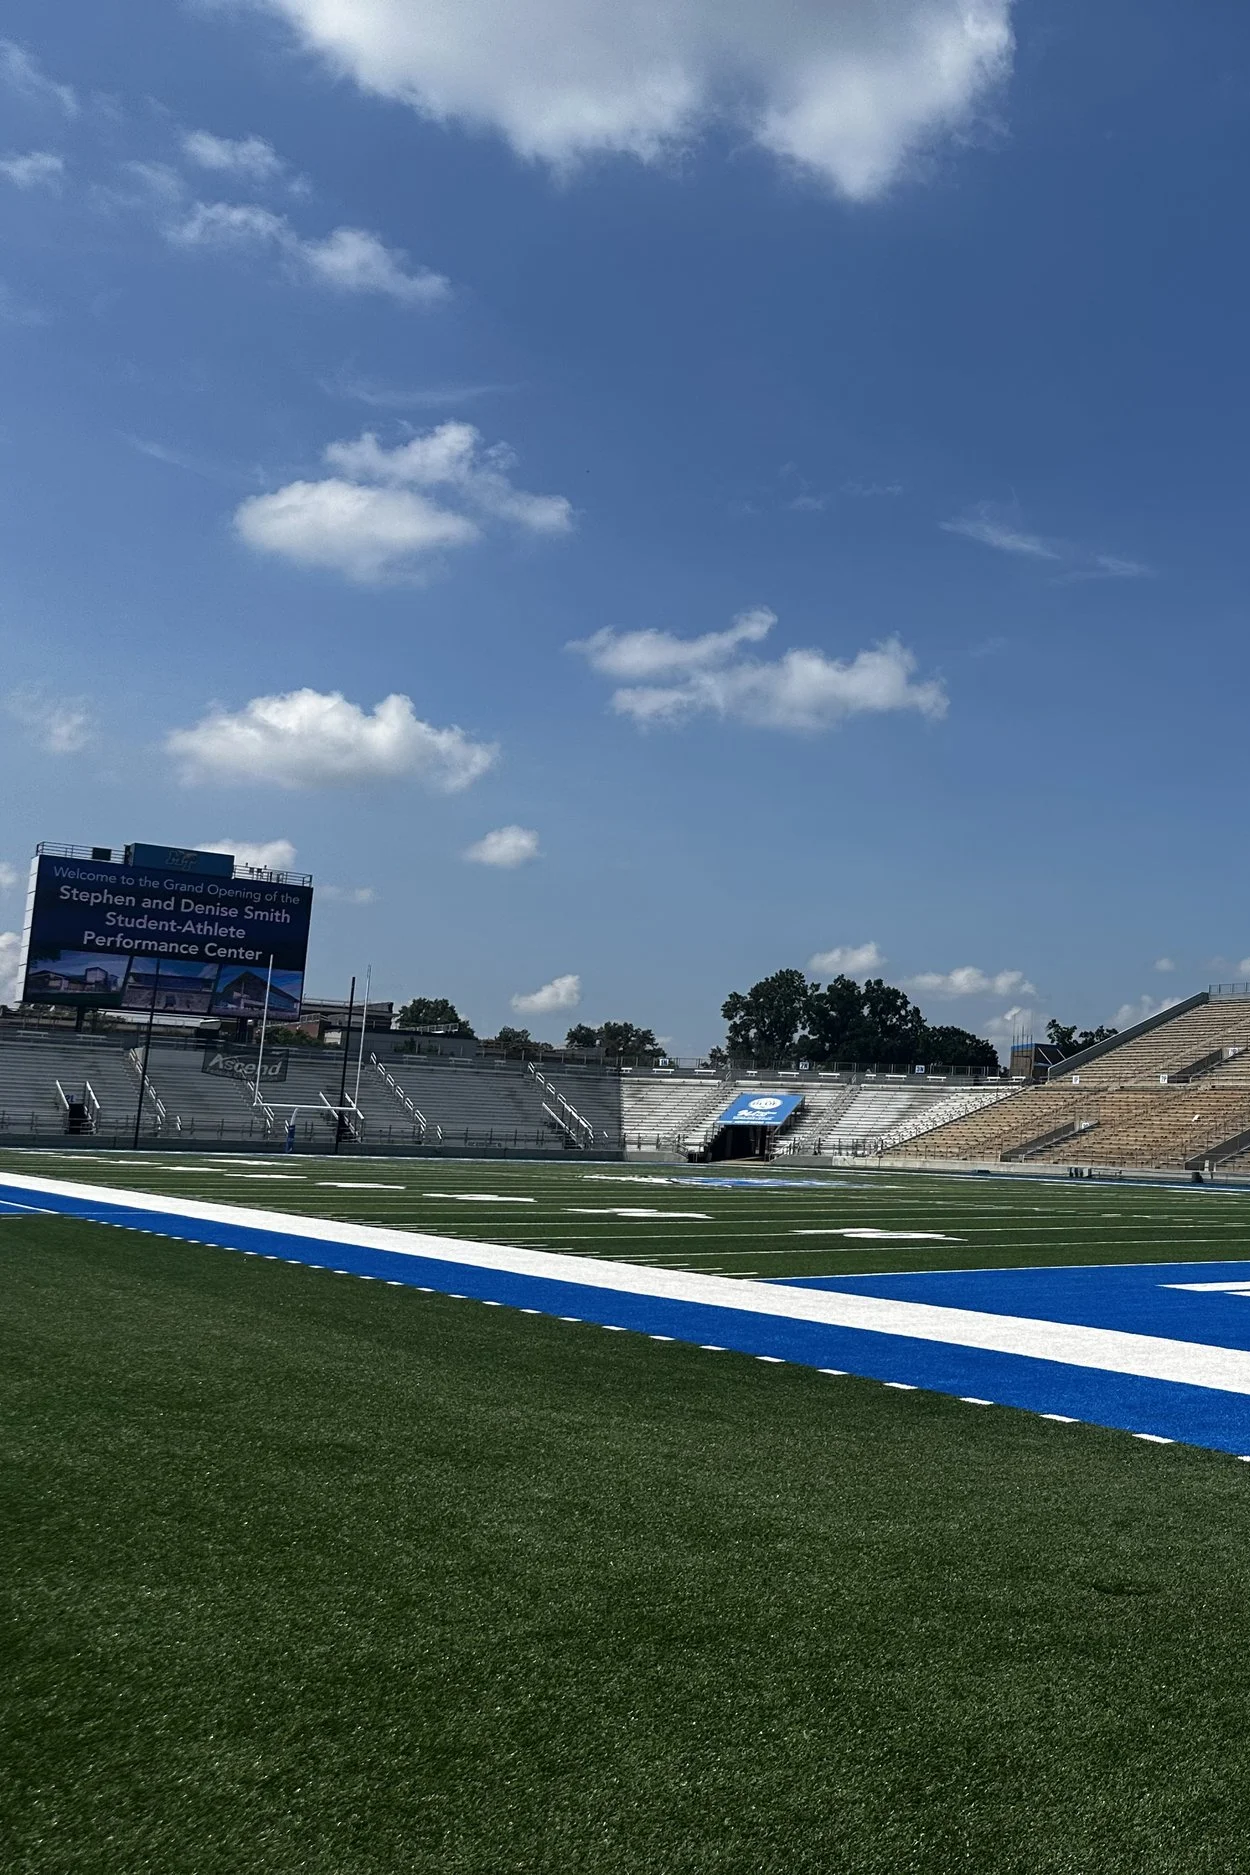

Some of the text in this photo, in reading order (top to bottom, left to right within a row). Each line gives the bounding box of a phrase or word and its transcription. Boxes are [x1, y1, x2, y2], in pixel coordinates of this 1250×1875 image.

[53, 866, 301, 905] Welcome to the Grand Opening of the
[59, 885, 291, 924] Stephen and Denise Smith
[105, 911, 247, 939] Student-Athlete
[82, 931, 263, 961] Performance Center
[209, 1053, 282, 1076] Ascend
